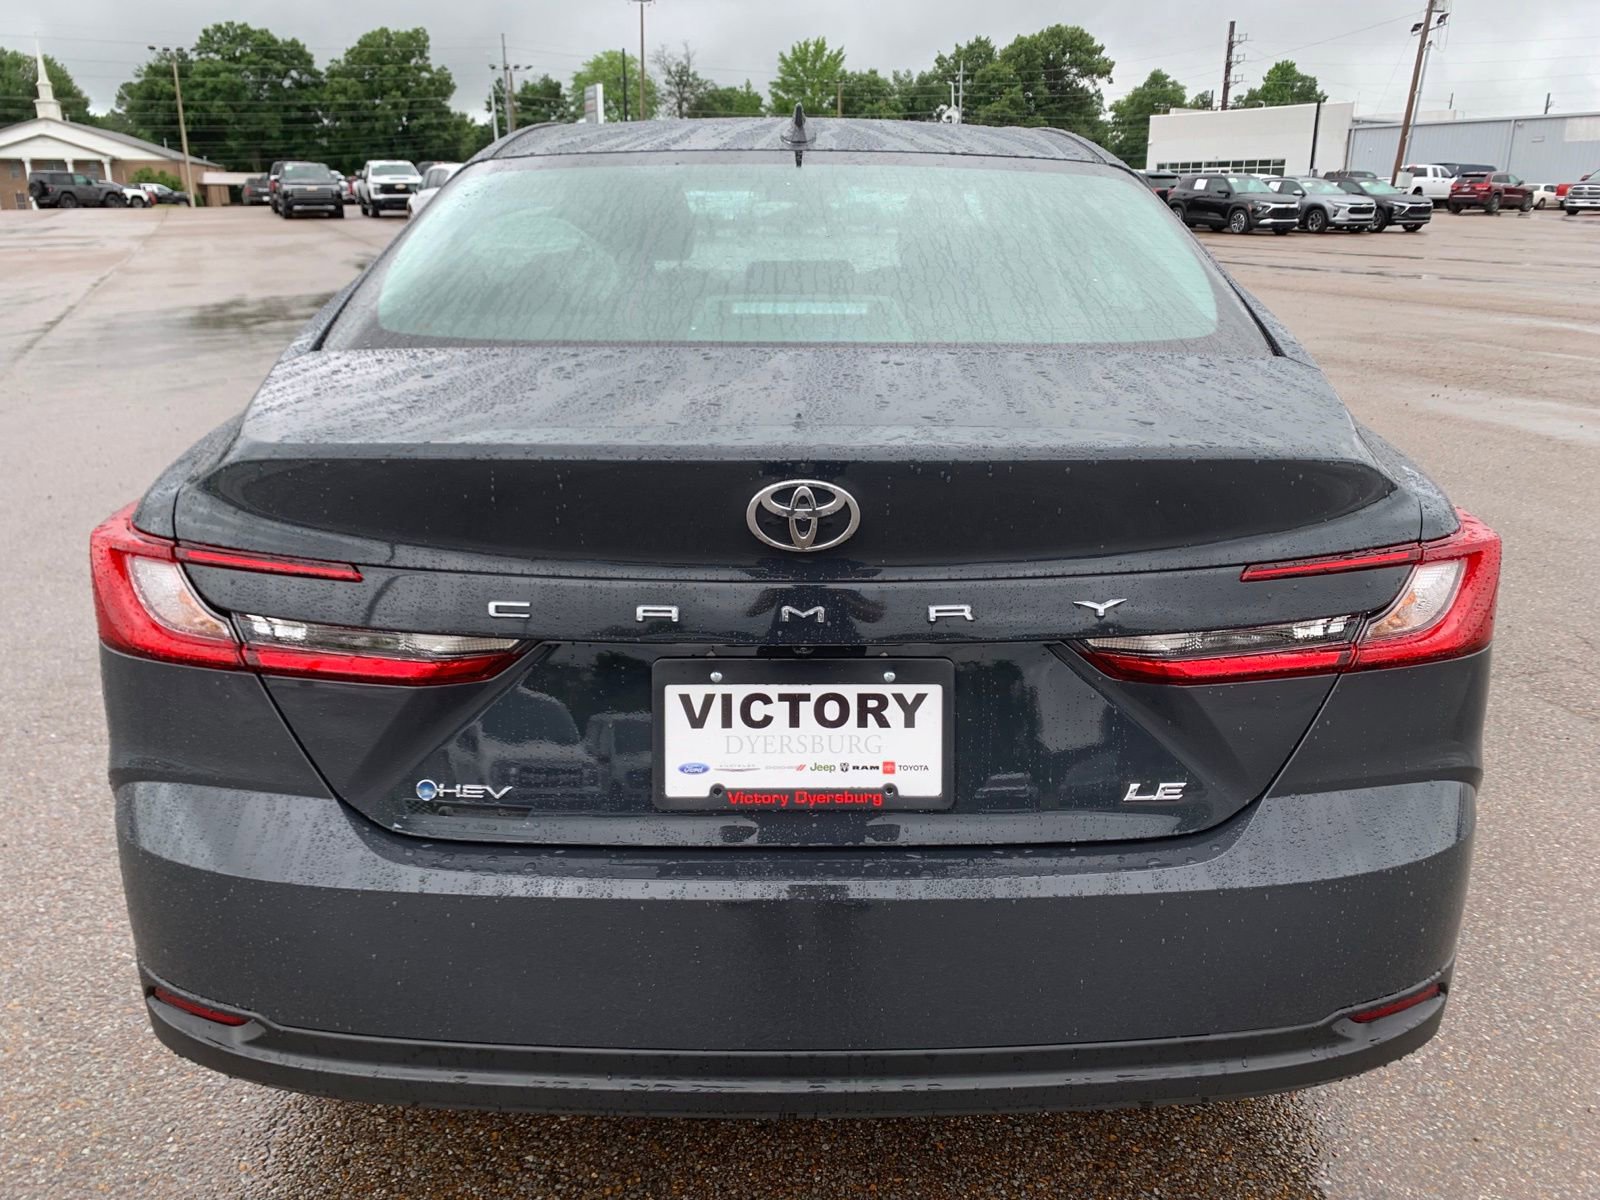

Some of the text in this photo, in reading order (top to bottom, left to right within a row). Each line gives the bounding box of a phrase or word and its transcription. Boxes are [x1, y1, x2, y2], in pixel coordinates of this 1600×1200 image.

[488, 599, 1127, 622] CAMRY
[678, 692, 929, 729] VICTORY
[725, 734, 882, 754] DYERSBURG
[809, 762, 836, 773] Jeep
[898, 764, 929, 772] TOYOTA
[438, 783, 513, 799] HEV
[727, 790, 883, 807] Victory Dyersburg
[1123, 782, 1188, 801] LE
